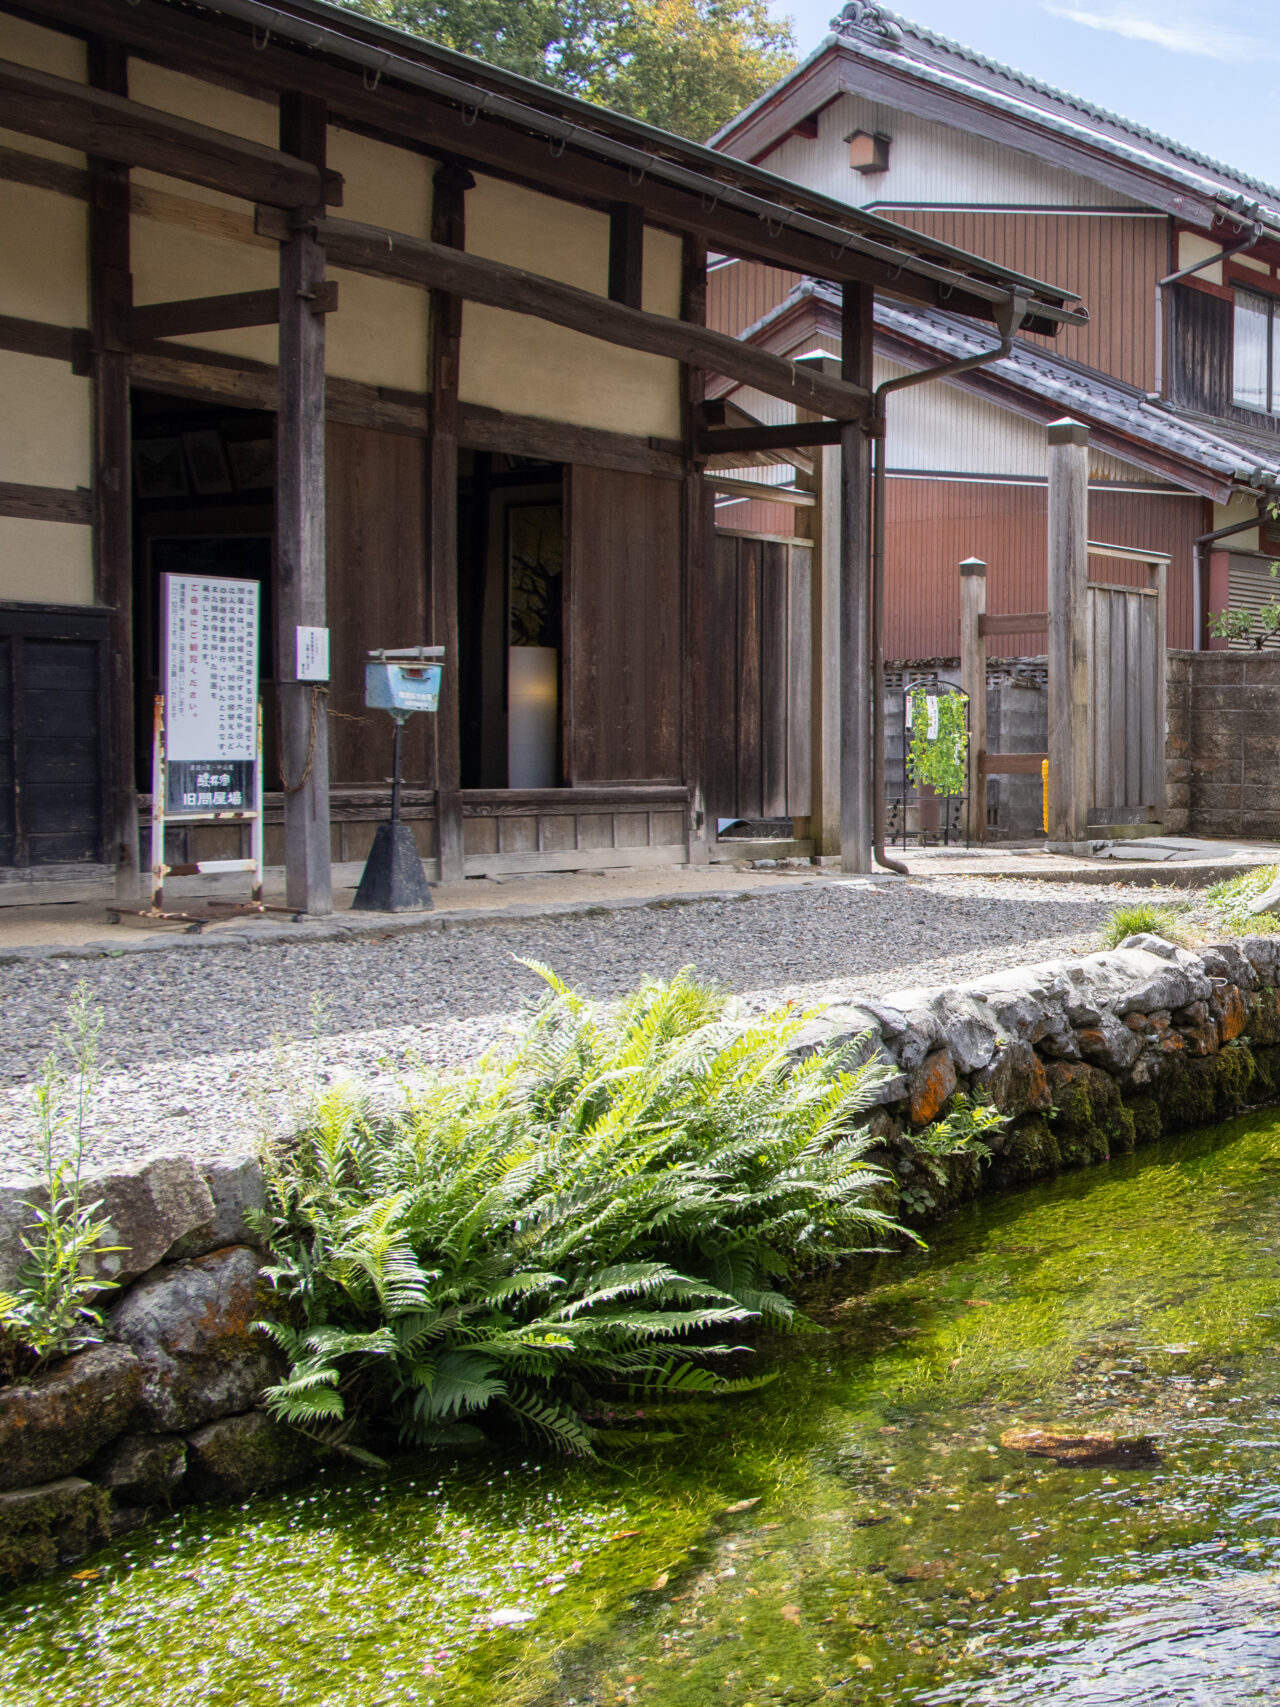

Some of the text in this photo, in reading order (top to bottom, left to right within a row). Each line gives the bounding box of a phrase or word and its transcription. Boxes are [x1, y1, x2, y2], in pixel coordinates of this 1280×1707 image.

[189, 584, 199, 717] ご自由にご観覧ください。
[196, 772, 231, 787] 醒井宿
[183, 791, 242, 806] 旧問屋場
